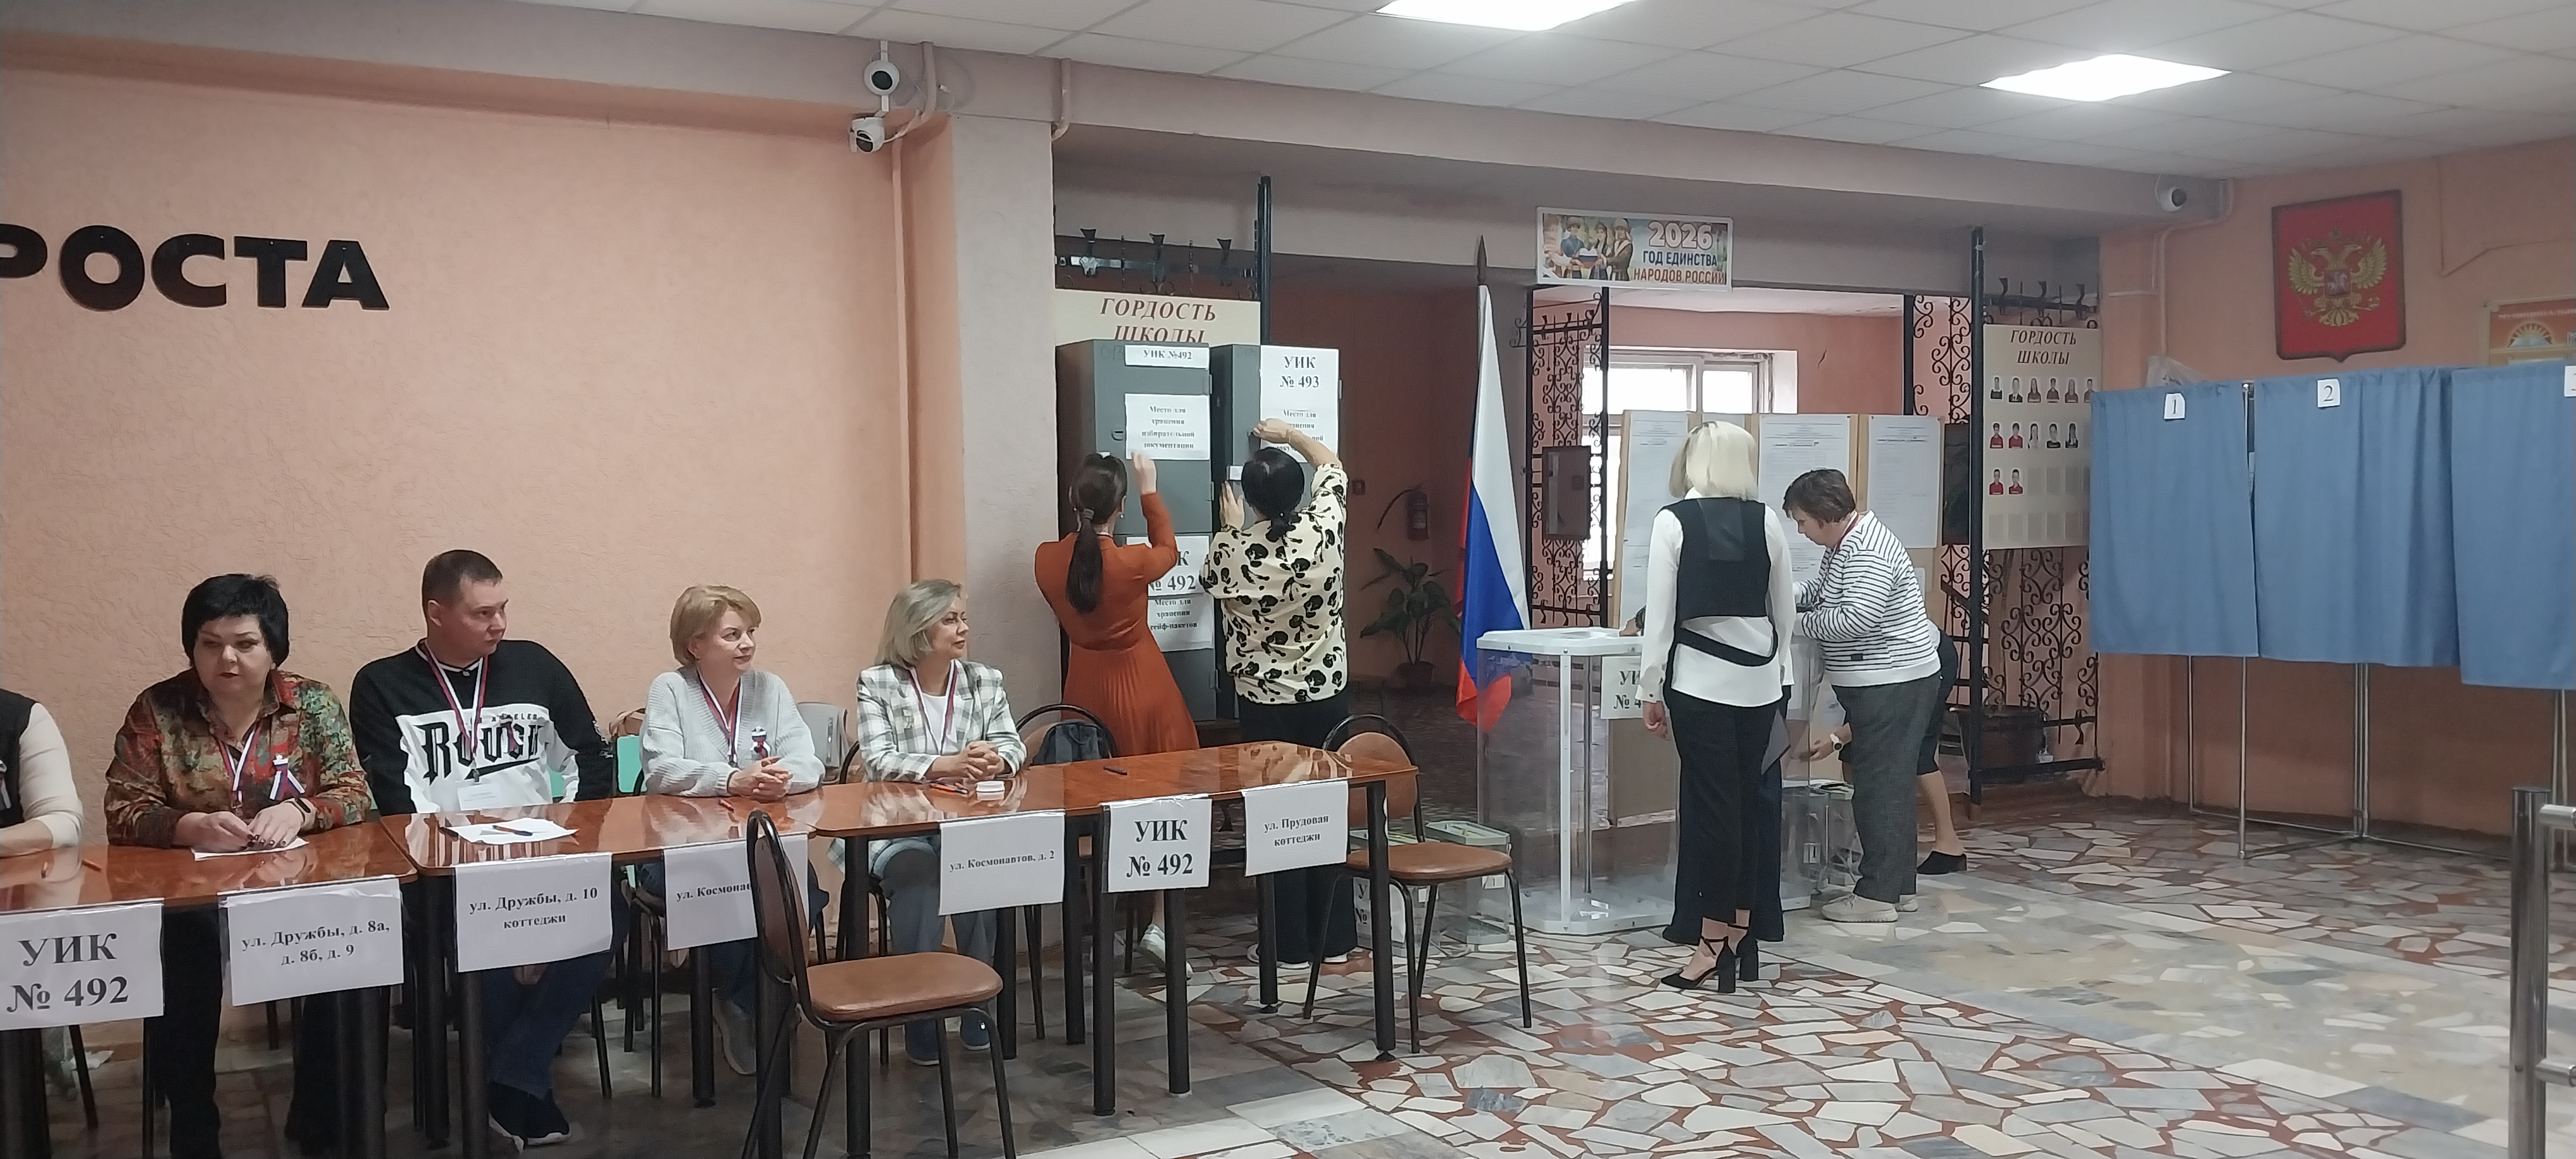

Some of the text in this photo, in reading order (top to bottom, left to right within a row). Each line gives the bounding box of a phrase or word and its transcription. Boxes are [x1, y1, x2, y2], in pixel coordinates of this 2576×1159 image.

[1647, 221, 1714, 250] 2026
[1643, 250, 1717, 267] ГОД ЕДИНСТВА
[1633, 268, 1726, 285] НАРОДОВ РОССИИ
[1100, 298, 1216, 321] ГОРДОСТЬ
[1114, 325, 1205, 343] ШКОЛЫ
[2010, 330, 2077, 346] ГОРДОСТЬ
[1143, 350, 1166, 359] УИК
[1284, 356, 1316, 369] УИК
[2017, 350, 2071, 365] ШКОЛЫ
[1280, 376, 1320, 388] № 493
[2323, 385, 2334, 402] 2
[1167, 574, 1196, 591] 492
[1613, 694, 1630, 710] №
[1135, 819, 1188, 843] УИК
[1264, 816, 1329, 834] ул. Прудовая
[1274, 833, 1320, 847] коттеджи
[950, 850, 1055, 873] ул. Космонавтов, д. 2
[1126, 853, 1193, 878] № 492
[469, 887, 598, 915] ул. Дружбы, д. 10
[676, 891, 694, 902] ул.
[503, 915, 566, 929] коттеджи
[242, 920, 390, 952] ул. Дружбы, д. 8а,
[18, 932, 118, 967] УИК
[281, 944, 355, 966] д. 8б, д. 9
[6, 977, 129, 1013] № 492
